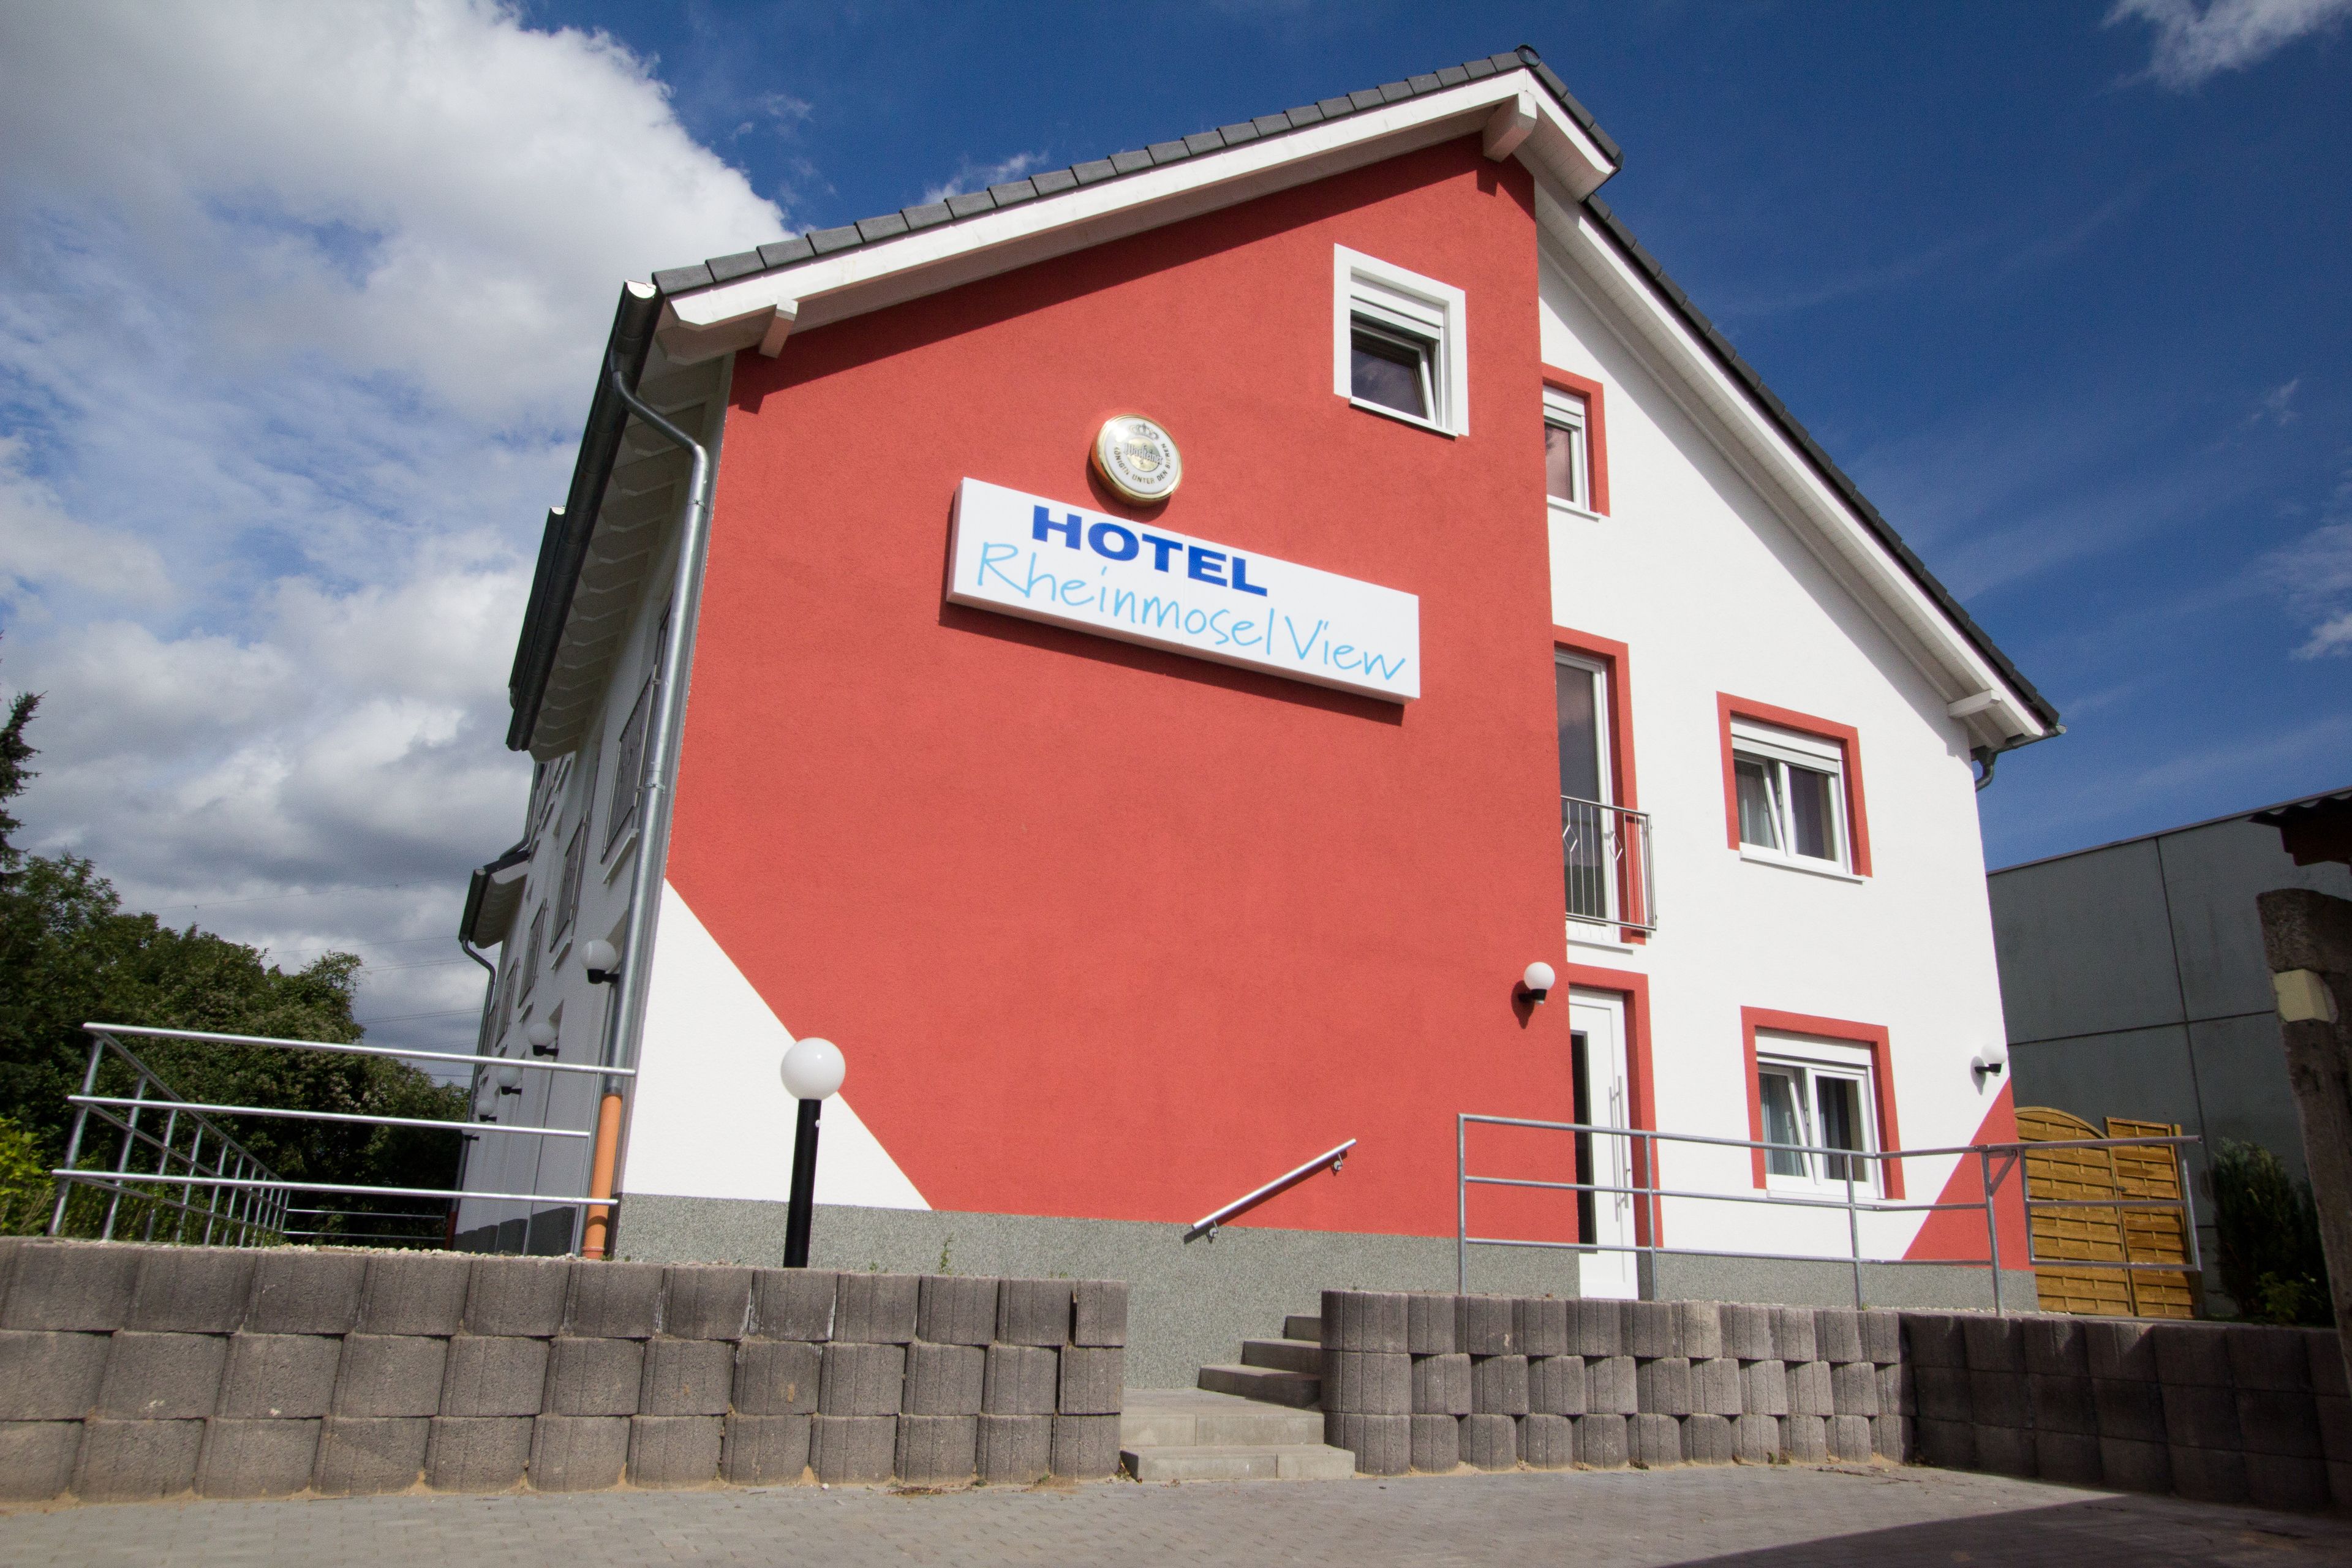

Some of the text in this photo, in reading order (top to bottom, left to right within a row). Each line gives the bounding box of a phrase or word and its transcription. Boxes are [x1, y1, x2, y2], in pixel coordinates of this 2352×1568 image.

[1161, 443, 1171, 469] BIEREN
[1132, 474, 1155, 484] UNTER
[1157, 470, 1168, 481] DEN
[1031, 504, 1268, 597] HOTEL
[1284, 615, 1406, 680] View
